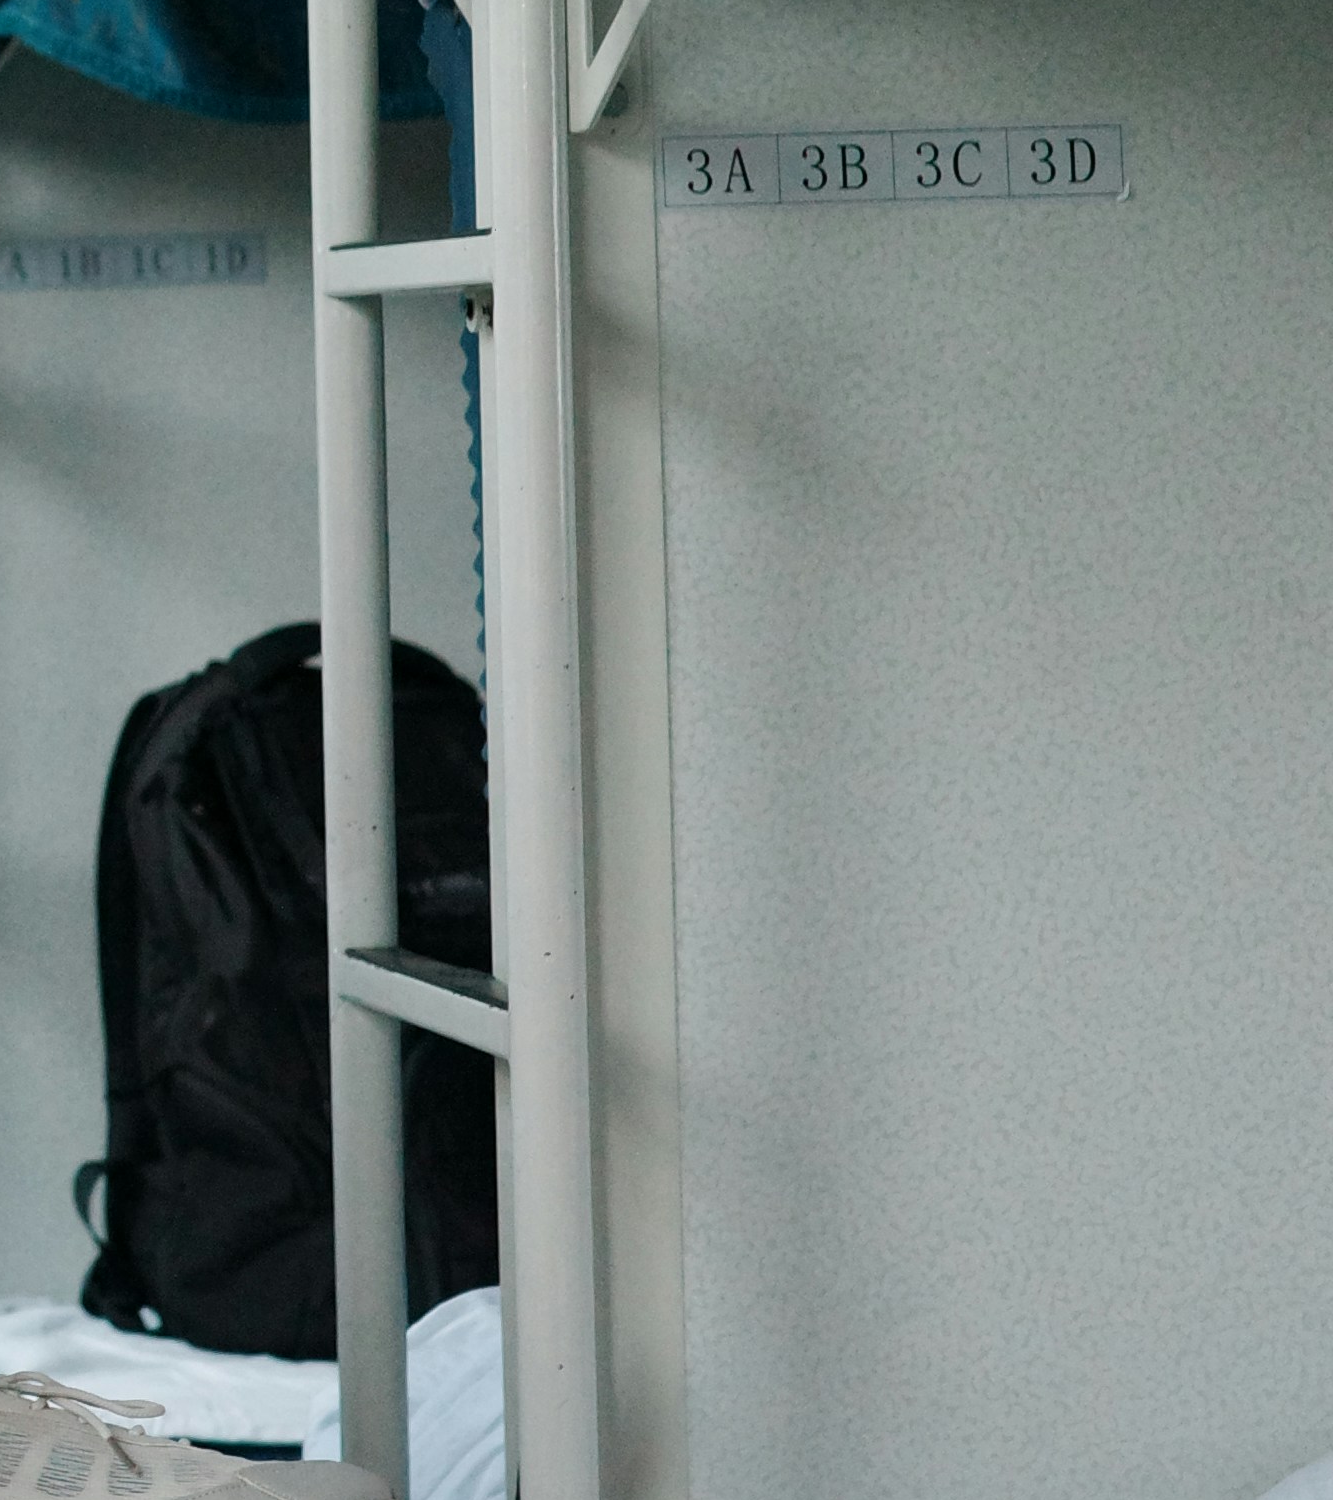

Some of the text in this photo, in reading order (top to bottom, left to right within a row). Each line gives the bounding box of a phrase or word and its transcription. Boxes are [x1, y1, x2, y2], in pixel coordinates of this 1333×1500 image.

[686, 137, 1096, 195] 3A 3B 3C 3D
